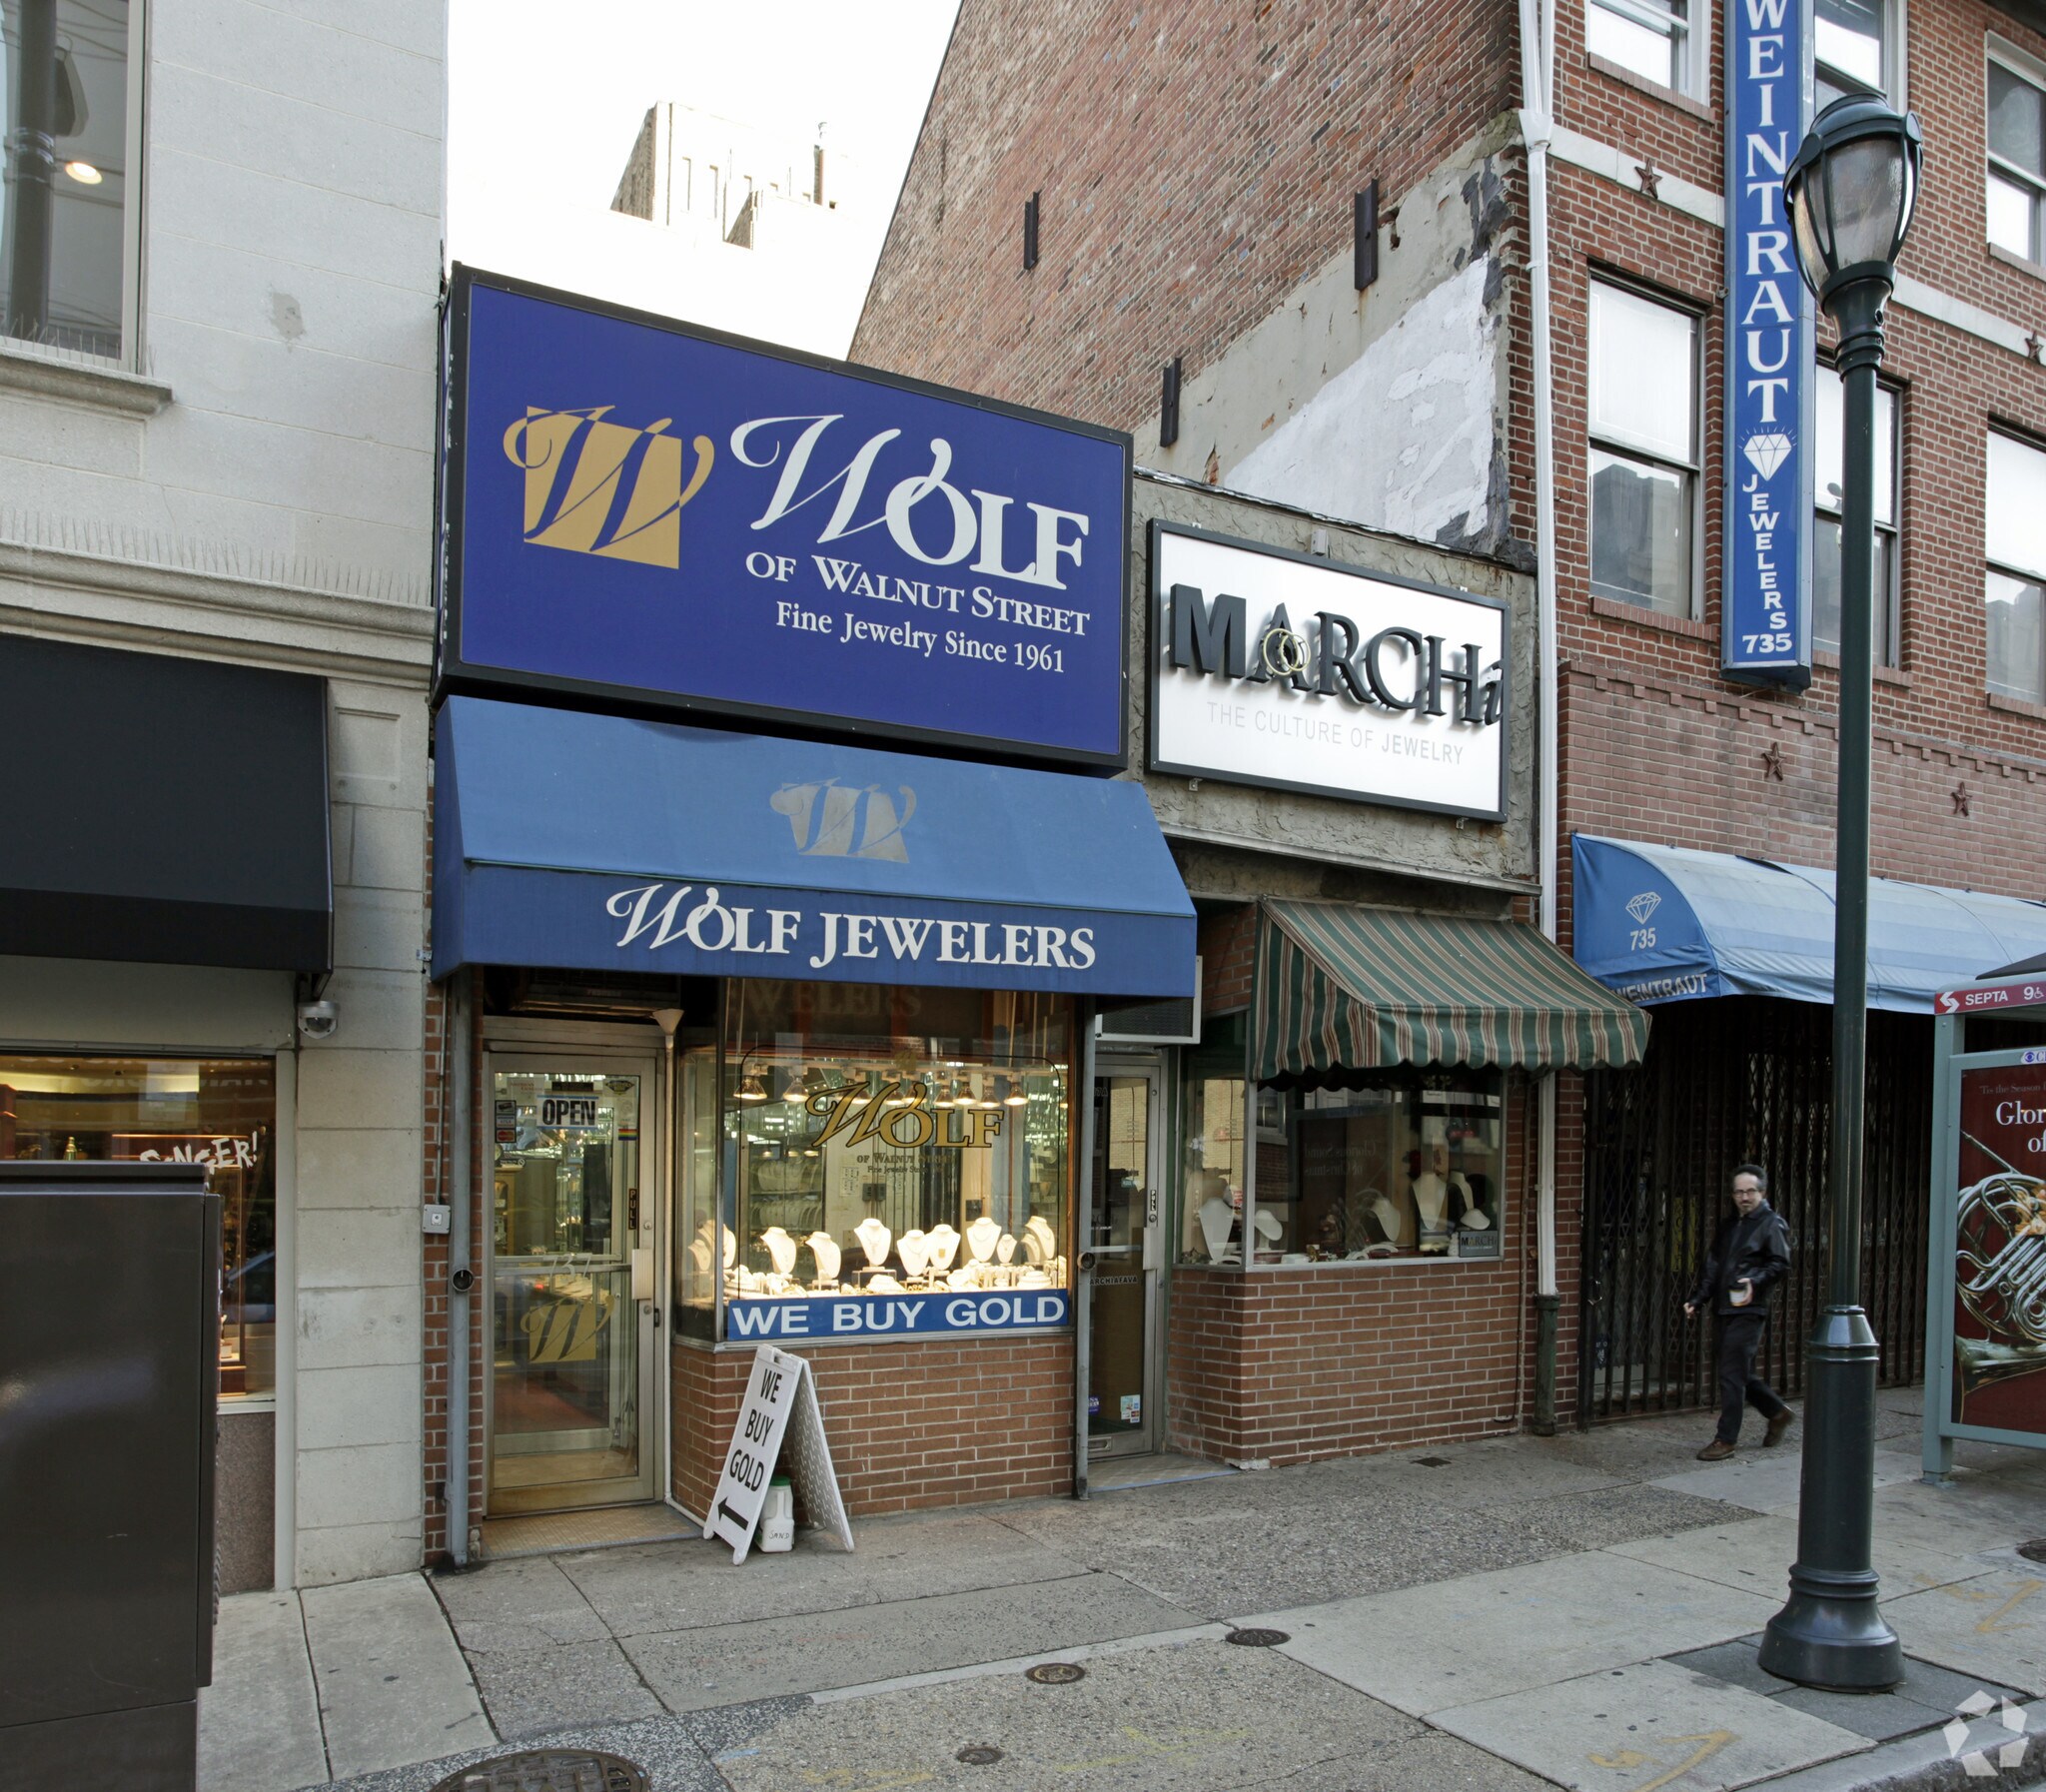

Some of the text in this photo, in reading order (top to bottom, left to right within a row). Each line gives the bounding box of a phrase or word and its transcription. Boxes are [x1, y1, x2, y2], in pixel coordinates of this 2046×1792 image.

[729, 414, 1090, 590] WOLF
[1742, 474, 1787, 630] JEWELERS
[744, 551, 1091, 636] OF WALNUT STREET
[775, 600, 1065, 674] Fine Jewelry Since 1961
[1742, 633, 1792, 654] 735
[1207, 701, 1464, 766] THE CULTURE OF JEWELRY
[605, 883, 1097, 970] WOLF JEWELERS
[1629, 928, 1655, 951] 735
[1965, 986, 2033, 1006] SEPTA 9
[542, 1100, 595, 1126] OPEN
[804, 1081, 1004, 1149] WOLF
[732, 1297, 1065, 1336] WE BUY GOLD
[760, 1368, 782, 1403] WE
[744, 1408, 774, 1447] BUY
[729, 1449, 764, 1492] GOLD
[768, 1529, 790, 1539] SAND
